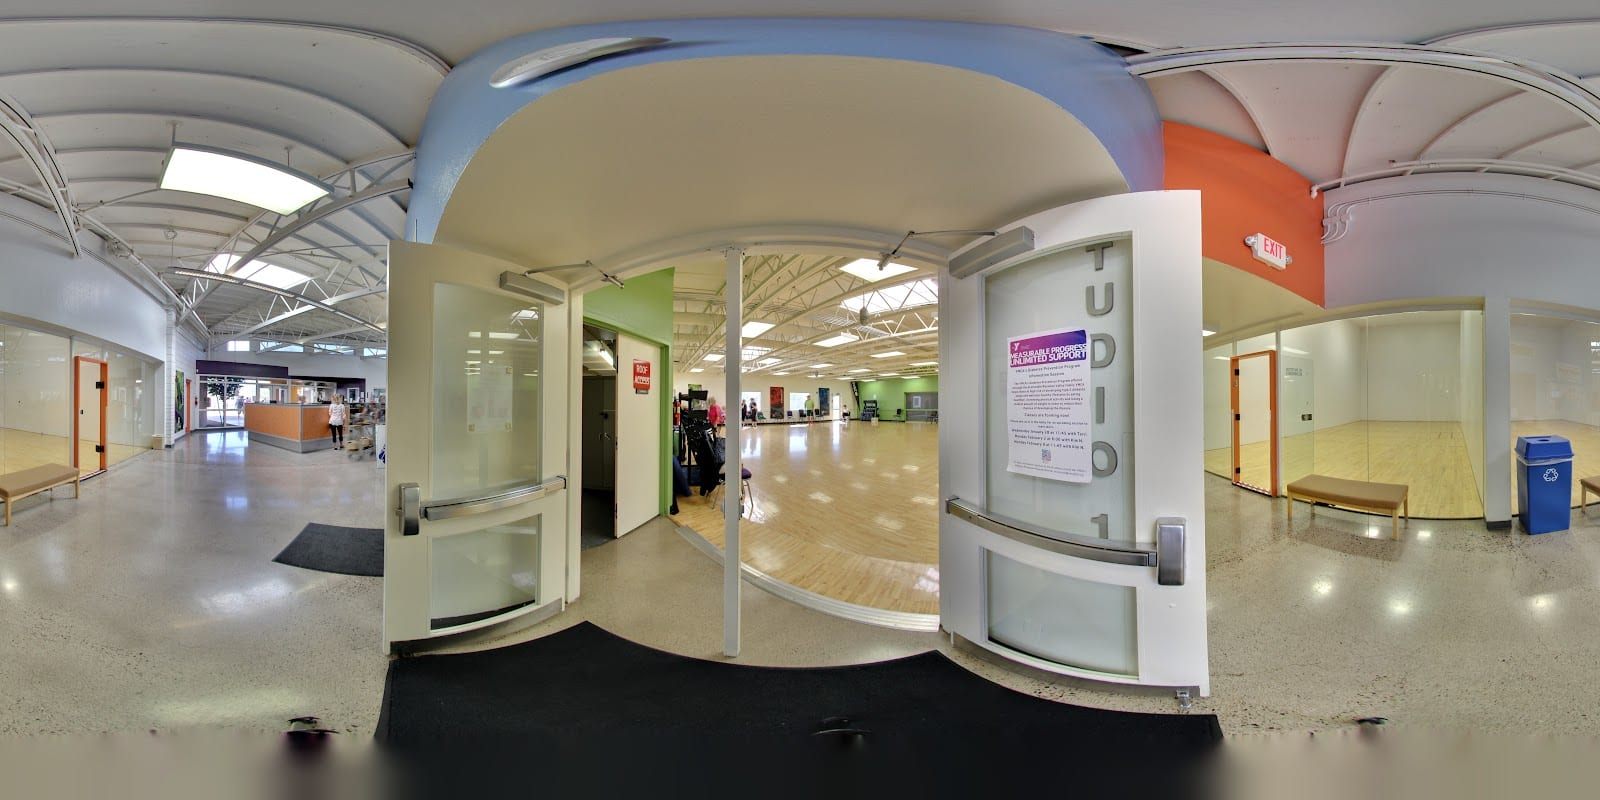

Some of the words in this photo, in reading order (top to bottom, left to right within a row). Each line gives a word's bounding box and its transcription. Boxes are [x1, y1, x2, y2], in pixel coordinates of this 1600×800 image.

[1264, 237, 1283, 260] EXIT
[1010, 347, 1050, 359] MEASURABLE
[1051, 343, 1086, 354] PROGRESS
[1010, 354, 1048, 366] UNLIMITED
[1048, 350, 1086, 361] SUPPORT
[636, 364, 649, 374] ROOF
